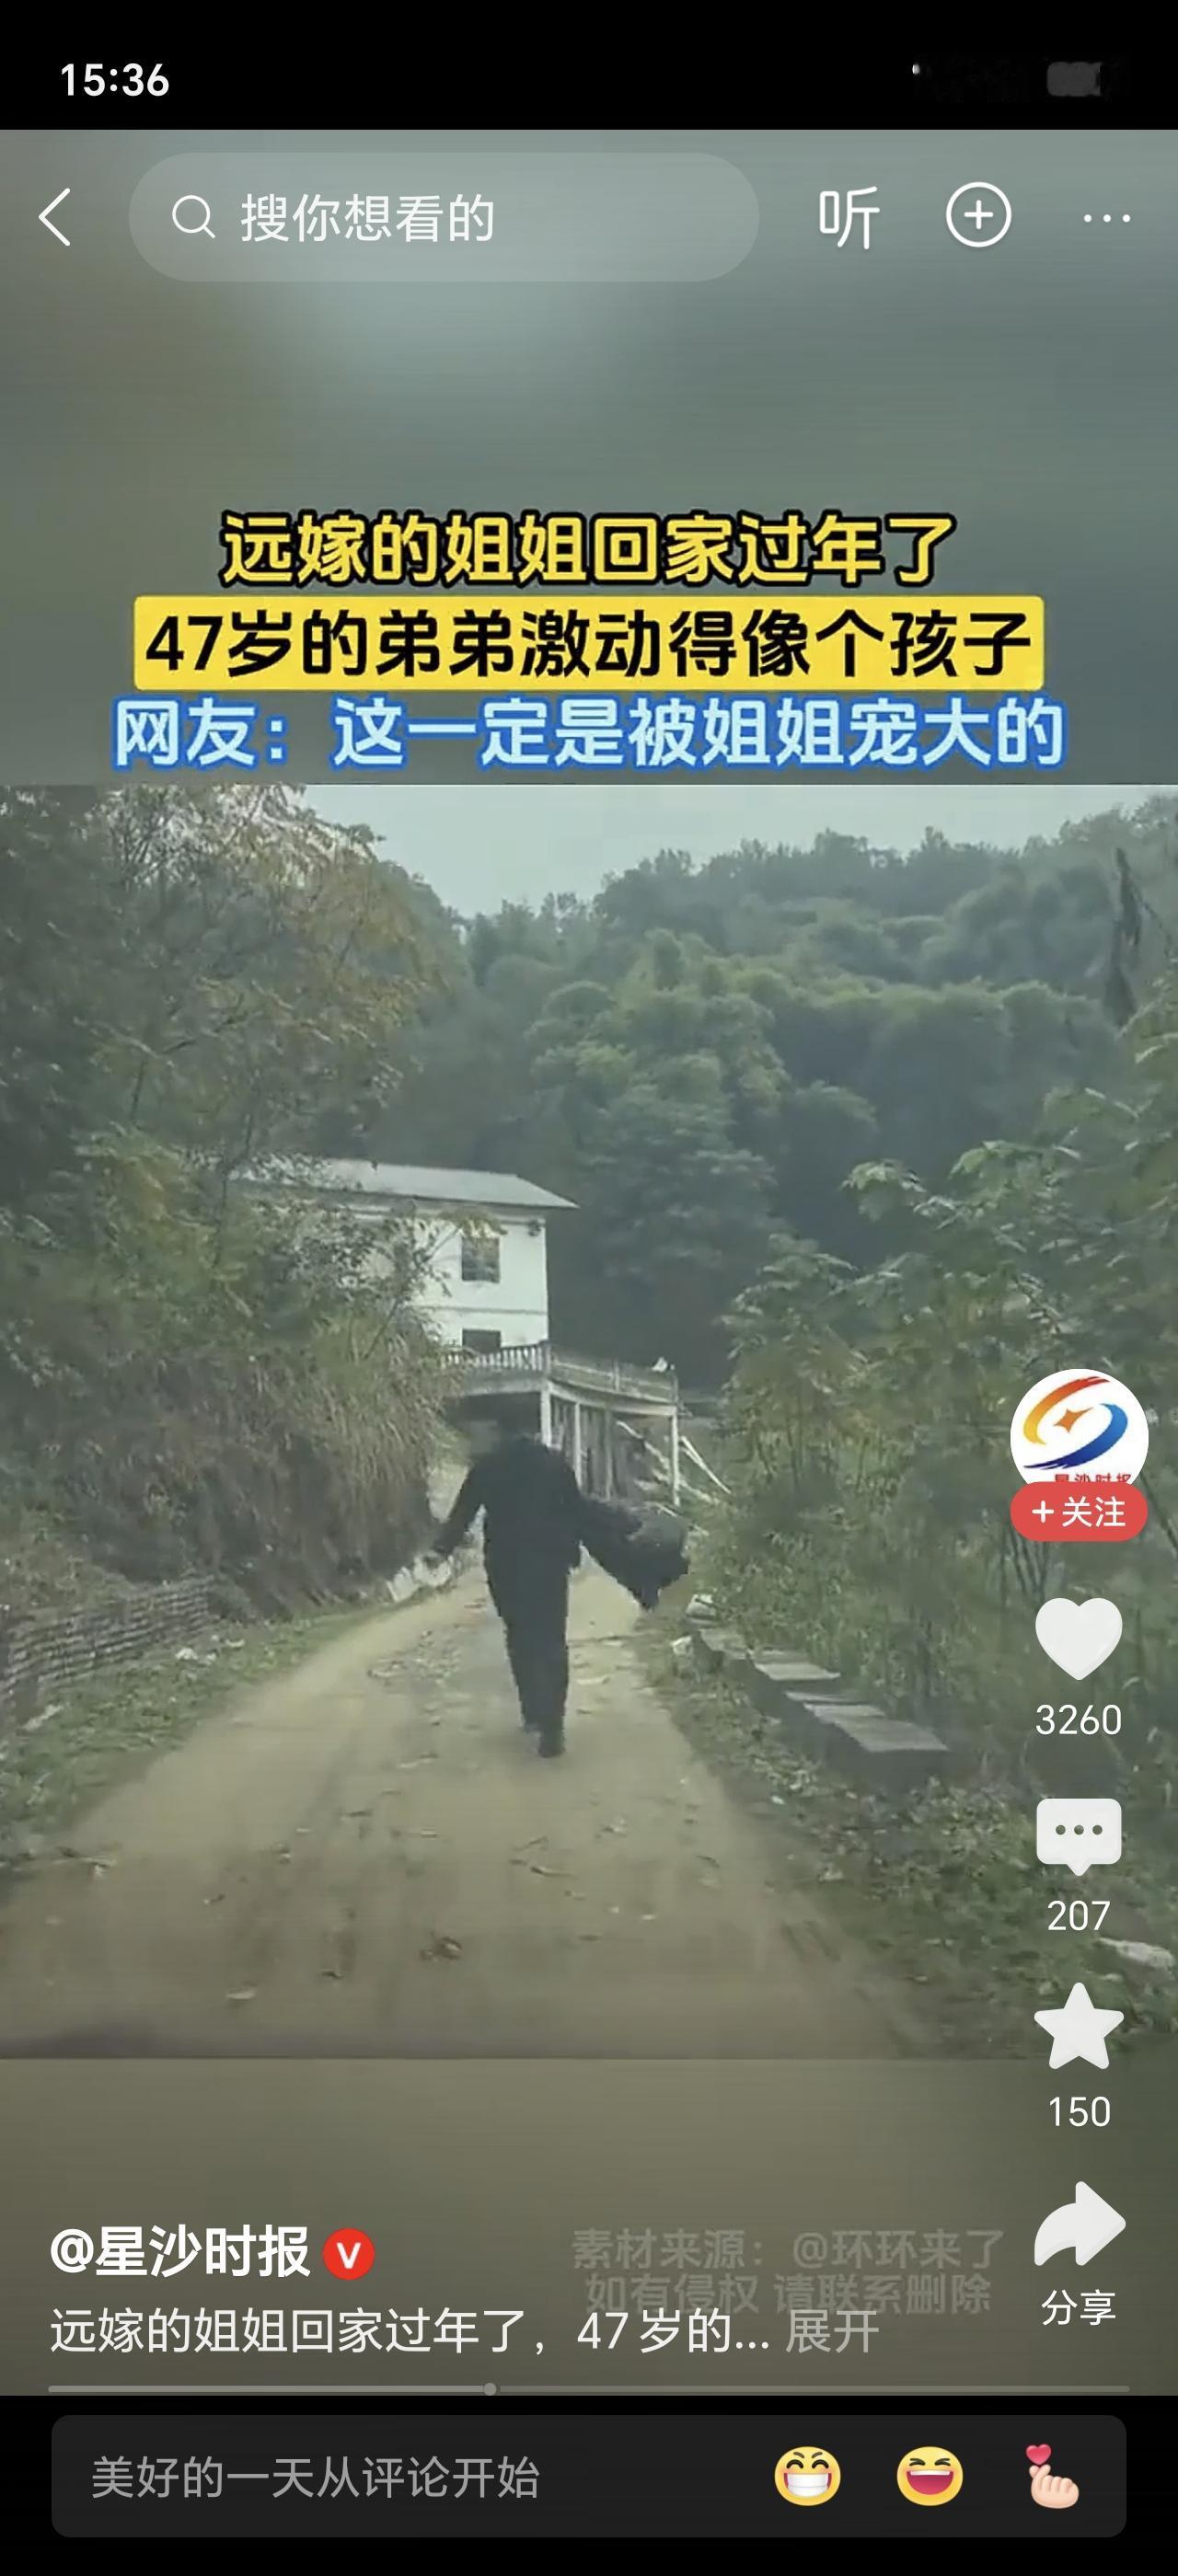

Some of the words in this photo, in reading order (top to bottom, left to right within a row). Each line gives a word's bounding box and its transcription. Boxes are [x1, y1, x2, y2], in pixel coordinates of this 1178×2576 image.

[61, 63, 170, 98] 15:36
[239, 192, 495, 244] 搜你想看的
[819, 186, 881, 250] 听
[1035, 1704, 1123, 1736] 3260
[1046, 1900, 1112, 1931] 207
[1049, 2096, 1112, 2127] 150
[49, 2223, 312, 2279] @星沙时报
[1040, 2288, 1117, 2327] 分享
[785, 2307, 881, 2354] 展开
[91, 2454, 541, 2500] 美好的一天从评论开始
